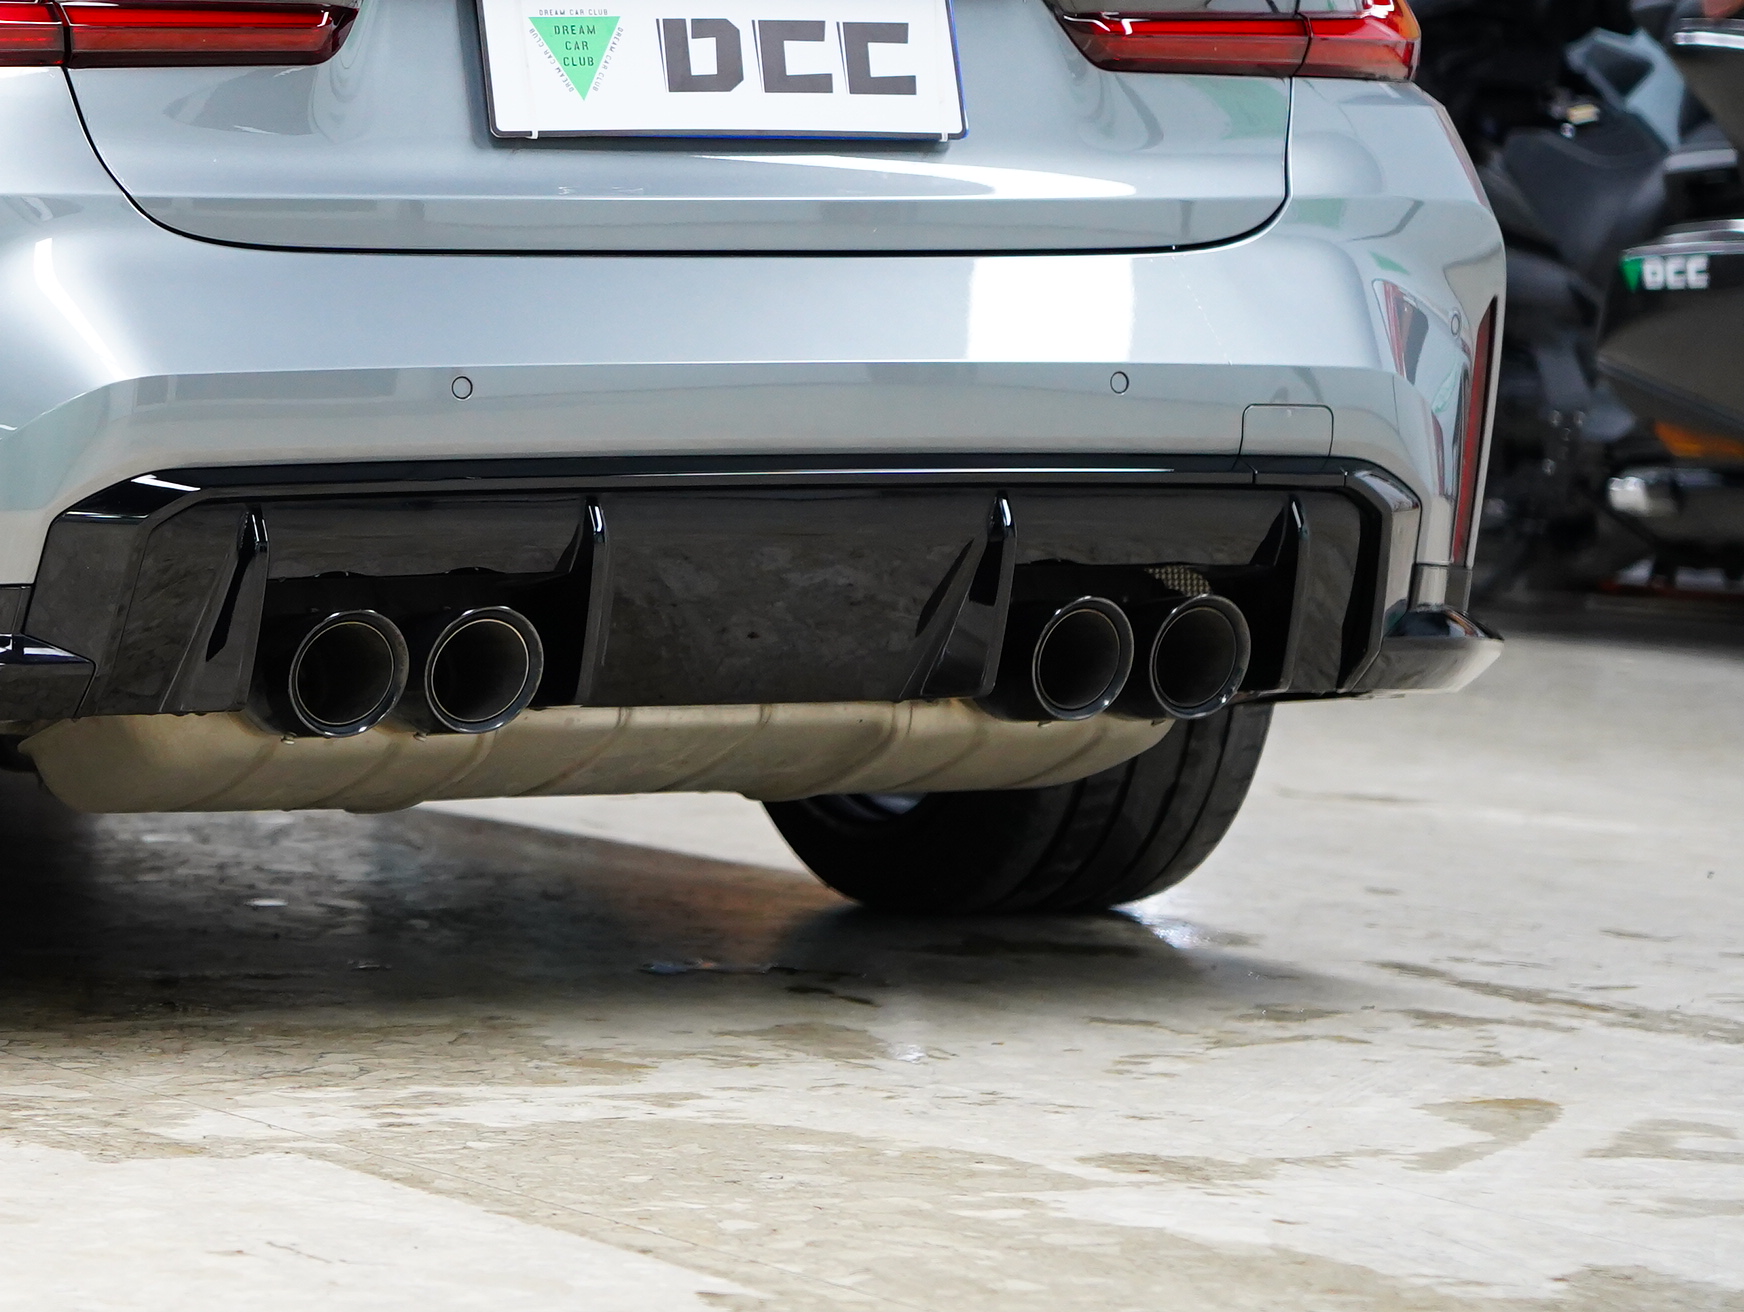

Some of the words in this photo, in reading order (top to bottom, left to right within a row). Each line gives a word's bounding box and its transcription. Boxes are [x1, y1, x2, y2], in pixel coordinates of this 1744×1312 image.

[588, 8, 608, 16] CLUB
[554, 24, 596, 35] DREAM
[565, 40, 589, 51] CAR
[609, 26, 624, 53] DREAM
[563, 56, 594, 67] CLUB
[601, 54, 612, 70] CAR
[656, 18, 917, 95] DCC
[592, 72, 605, 92] CLUB
